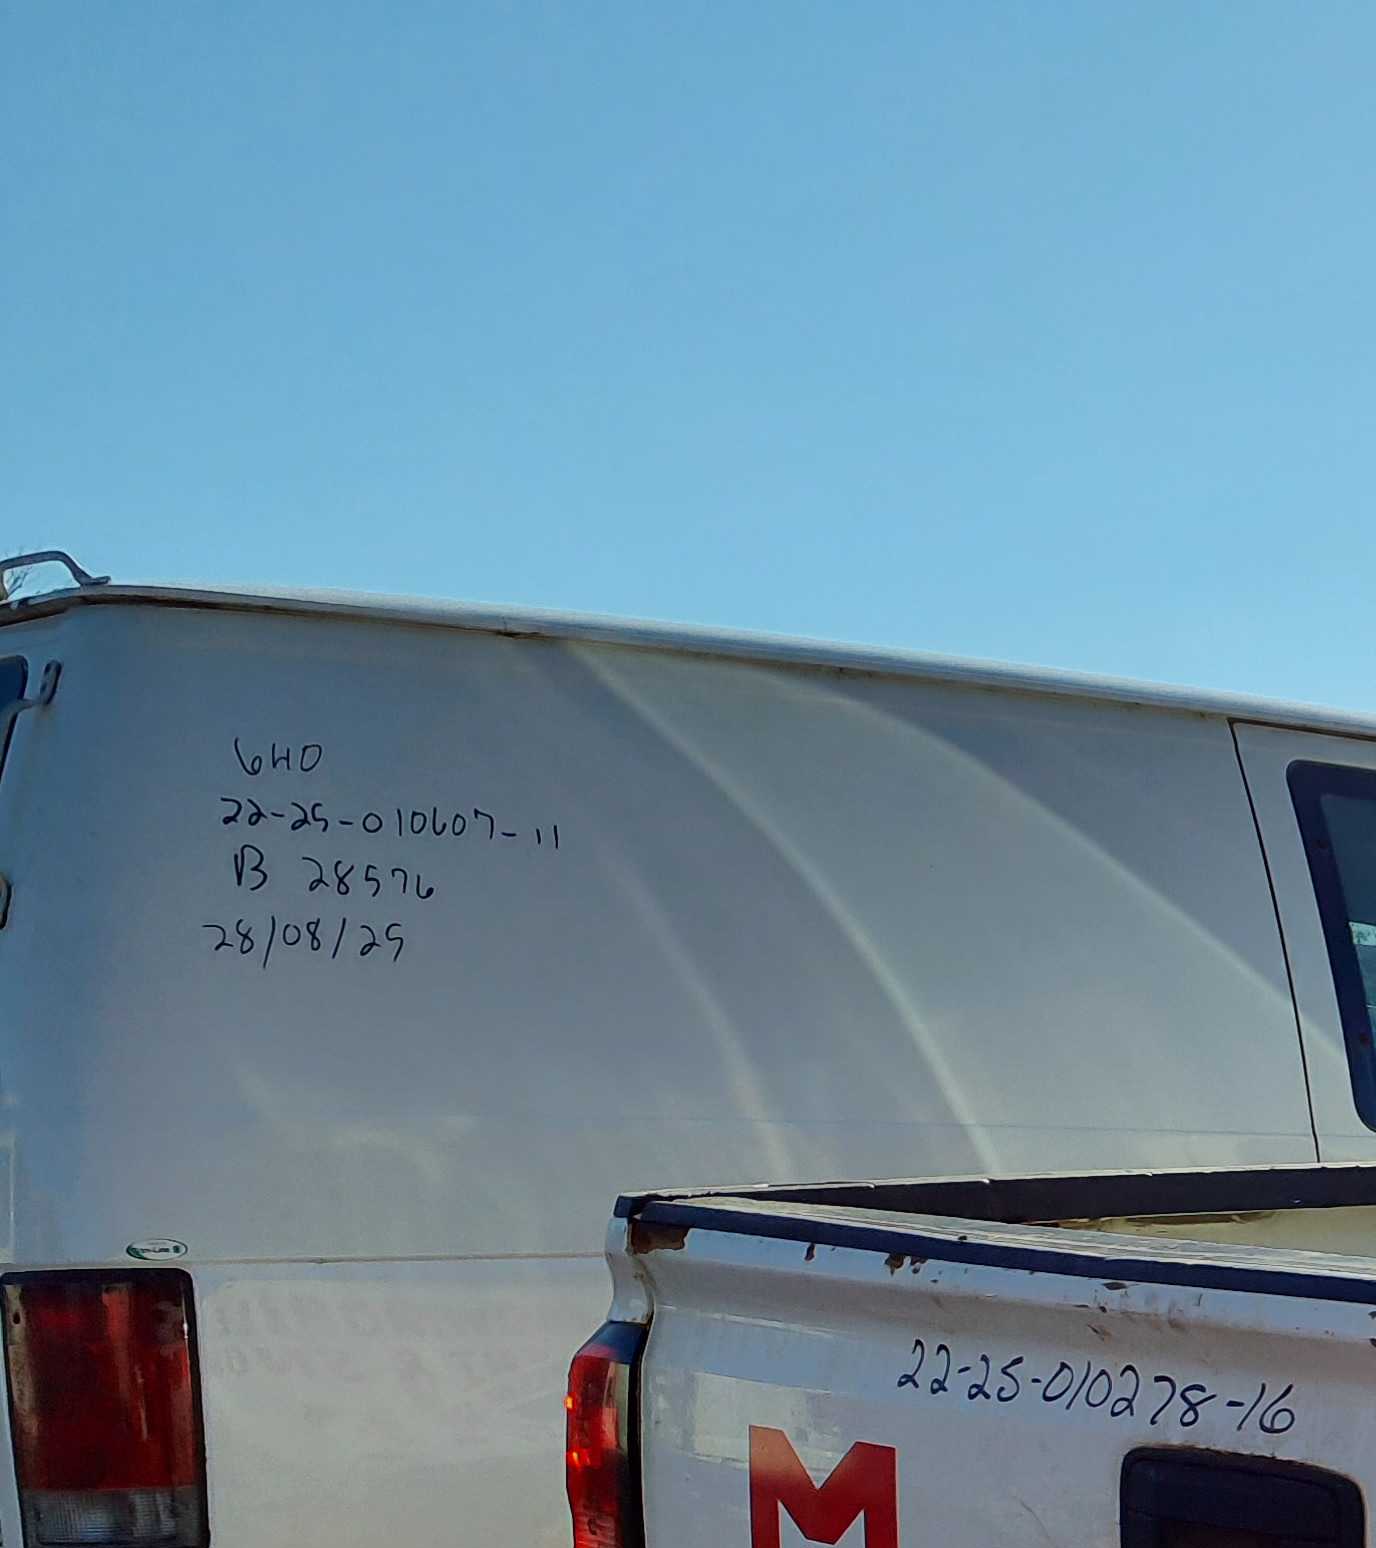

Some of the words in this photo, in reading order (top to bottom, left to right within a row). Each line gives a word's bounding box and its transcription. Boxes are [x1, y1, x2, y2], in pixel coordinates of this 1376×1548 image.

[220, 797, 560, 849] 22-25-010607-11
[302, 856, 435, 899] 28576
[202, 915, 404, 968] 28/08/25
[897, 1338, 1296, 1434] 22-25-010278-16
